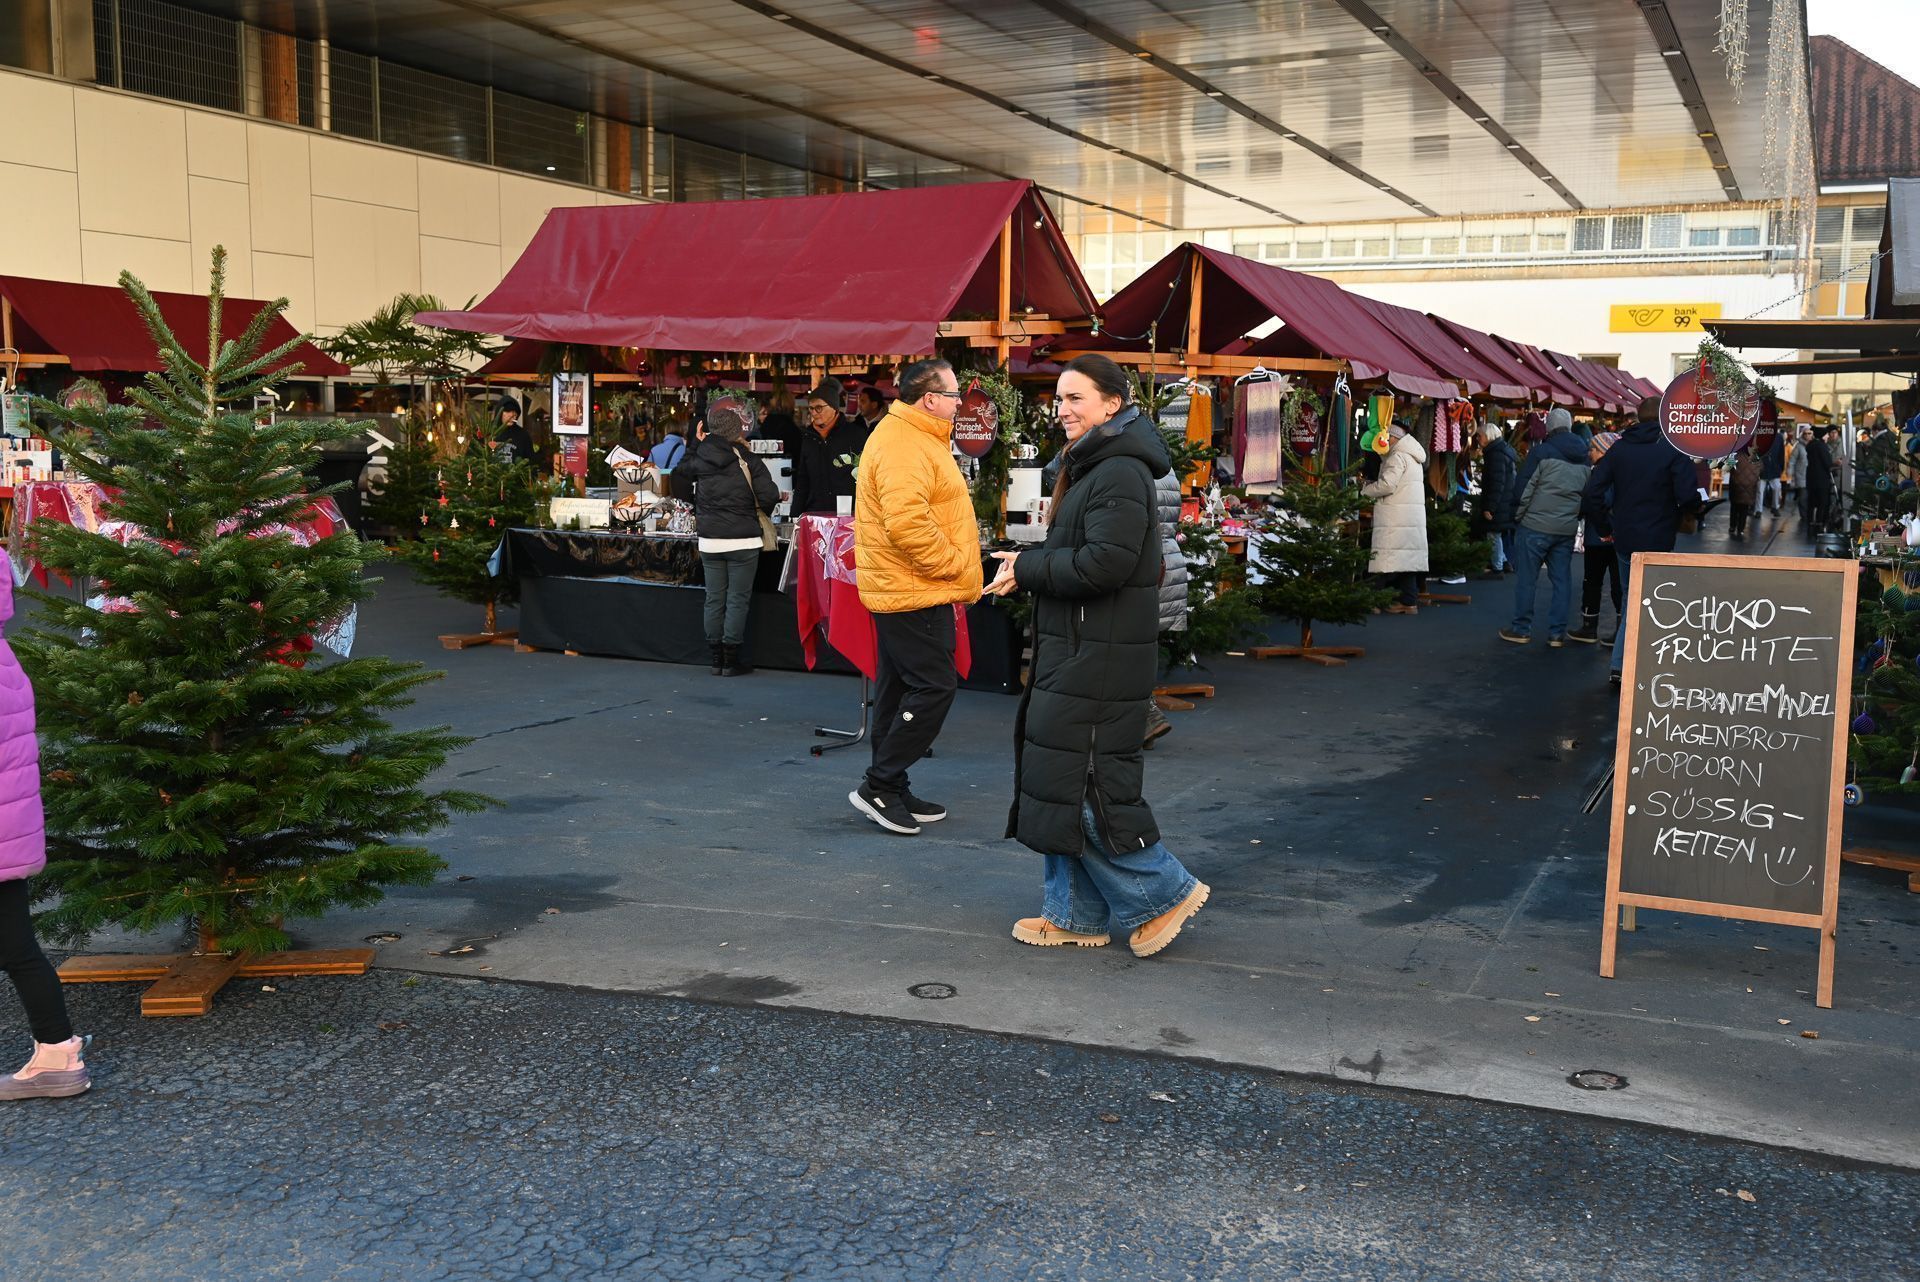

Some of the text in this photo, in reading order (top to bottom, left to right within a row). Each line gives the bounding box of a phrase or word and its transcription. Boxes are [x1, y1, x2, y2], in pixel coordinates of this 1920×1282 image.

[1674, 307, 1697, 316] bank
[1674, 315, 1691, 328] 99
[955, 431, 992, 441] kendlimarkt
[1668, 422, 1746, 435] kendlimarkt
[1650, 632, 1833, 665] FRÜCHTE
[1645, 711, 1822, 751] MAGENBROT
[1637, 746, 1763, 788] POPCORN
[1653, 827, 1757, 864] KEITEN
